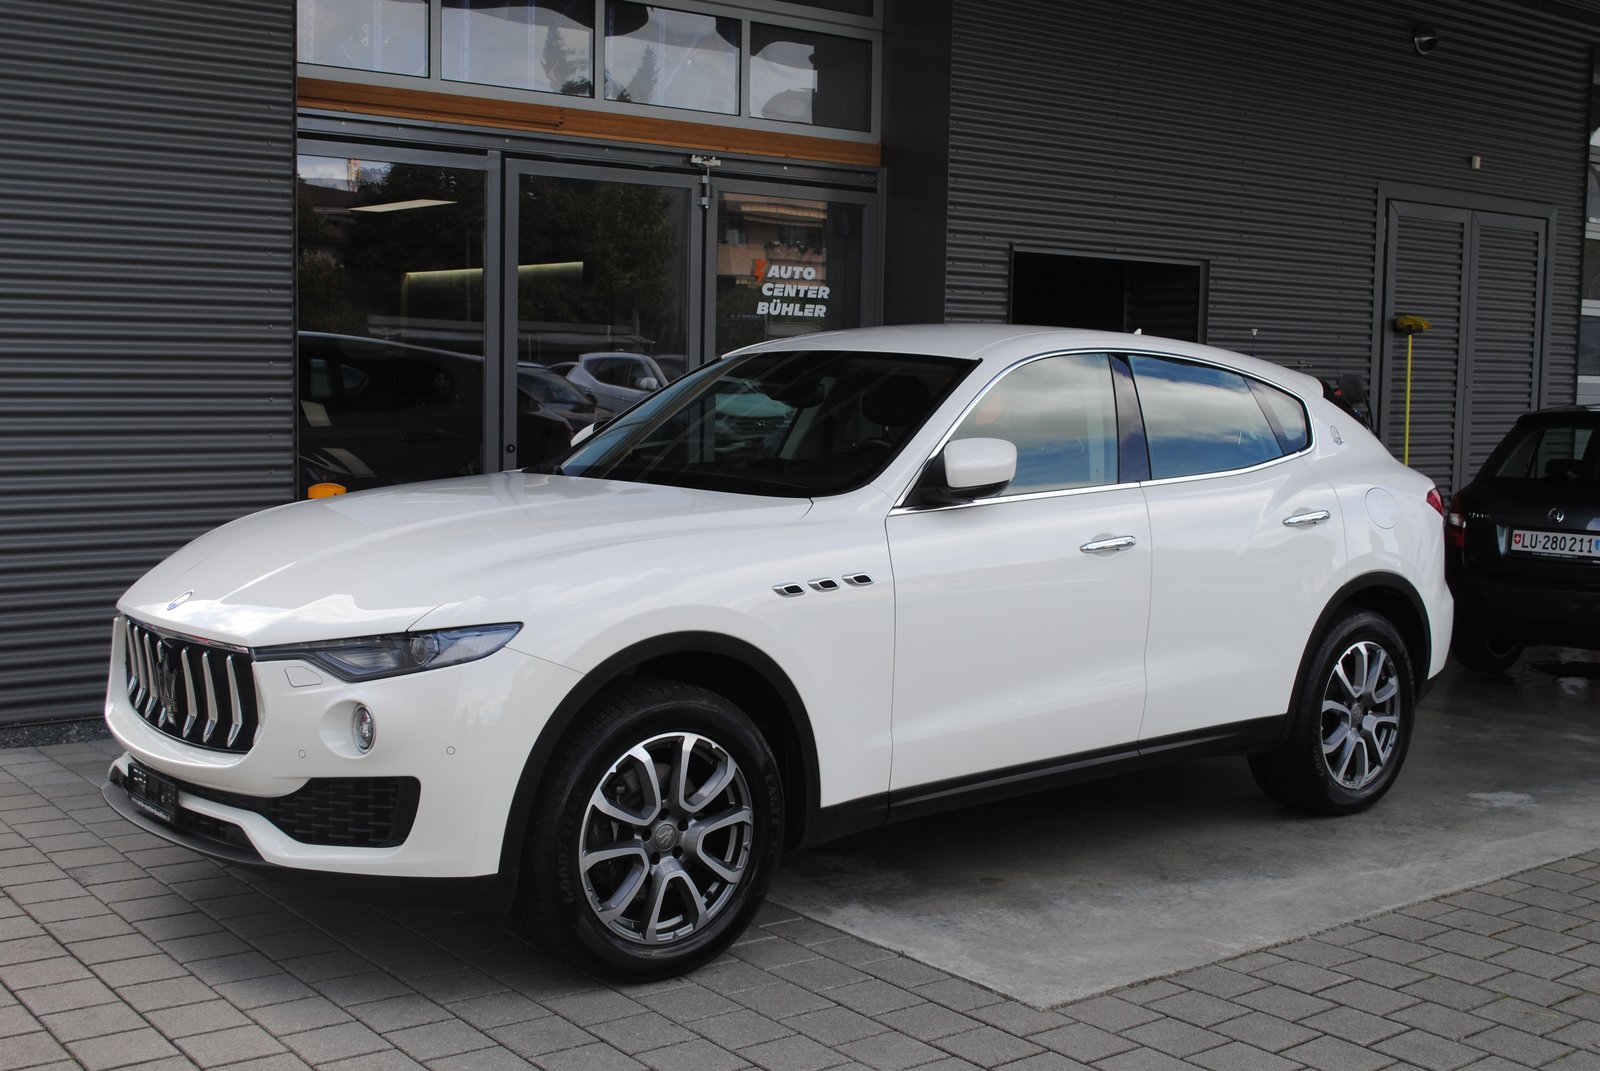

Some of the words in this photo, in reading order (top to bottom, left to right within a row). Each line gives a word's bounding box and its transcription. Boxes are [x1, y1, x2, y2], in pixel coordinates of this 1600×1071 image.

[767, 265, 816, 280] AUTO
[762, 282, 830, 299] CENTER
[756, 299, 827, 317] BÜHLER
